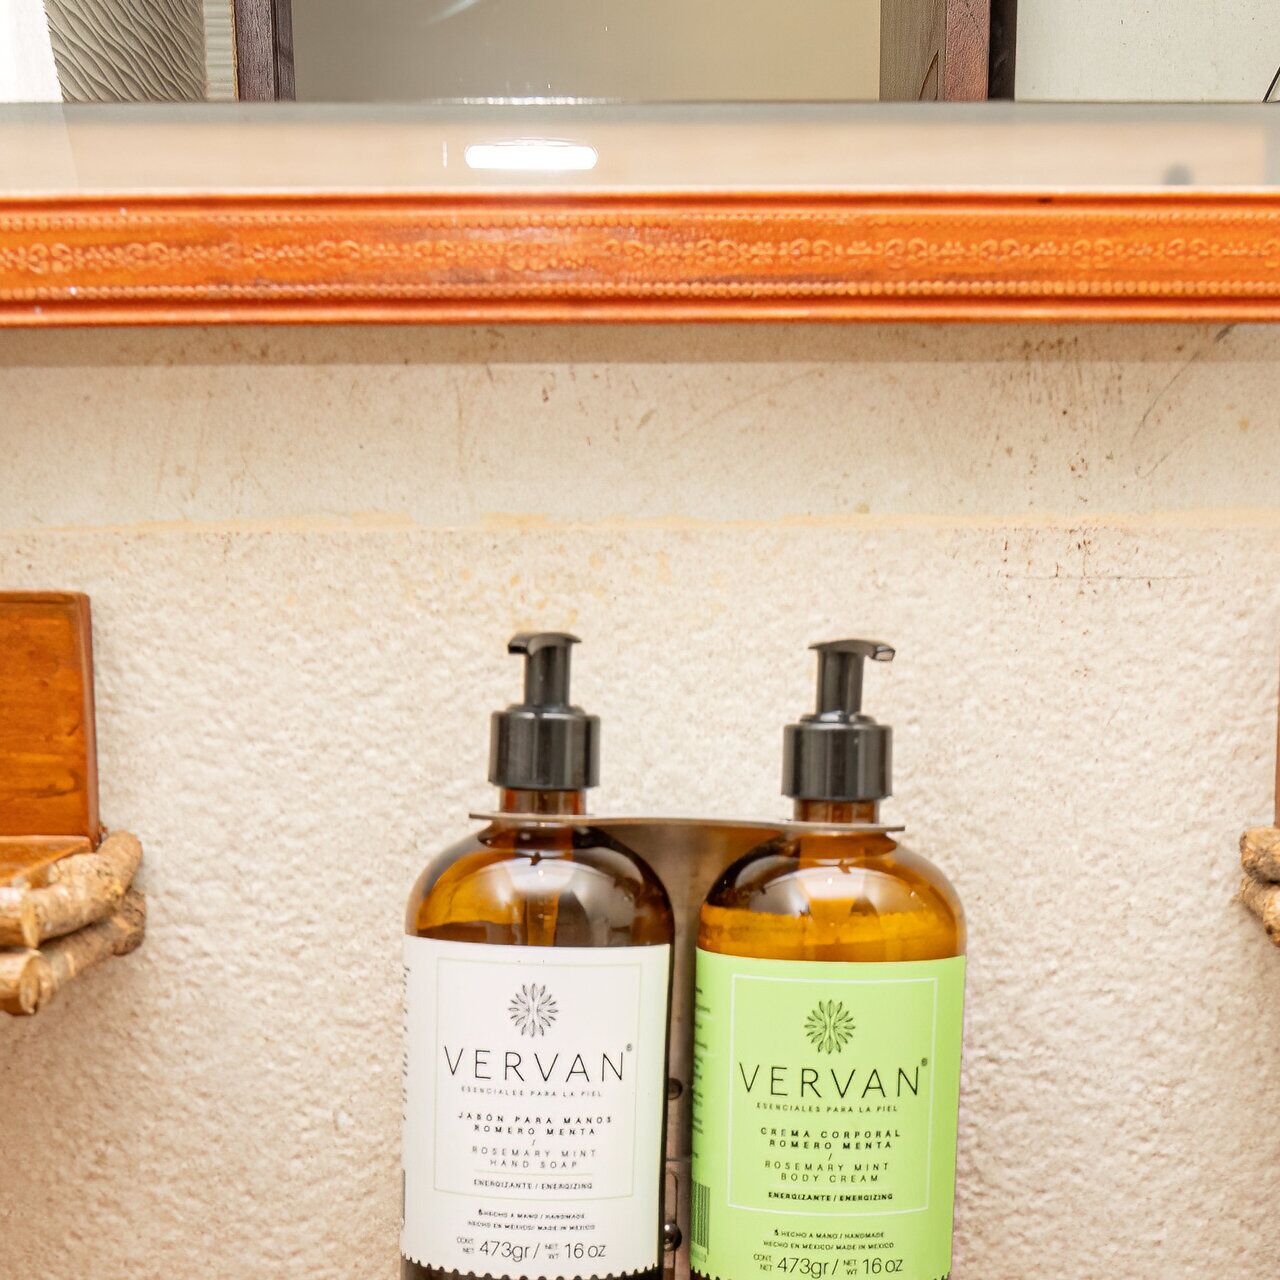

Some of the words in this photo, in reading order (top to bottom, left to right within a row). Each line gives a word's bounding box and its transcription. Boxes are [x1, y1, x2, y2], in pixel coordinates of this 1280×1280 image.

[756, 1102, 820, 1112] ESENCIALES
[515, 1116, 553, 1124] PARA
[563, 1116, 612, 1124] MANOS
[474, 1124, 535, 1135] ROMERO
[546, 1128, 595, 1136] MENTA
[760, 1127, 810, 1138] CREMA
[820, 1129, 901, 1139] CORPORAL
[769, 1139, 832, 1149] ROMERO
[842, 1141, 892, 1149] MENTA
[471, 1146, 551, 1158] ROSEMARY
[561, 1149, 596, 1158] MINT
[490, 1160, 530, 1169] HAND
[540, 1161, 578, 1169] SOAP
[764, 1160, 844, 1171] ROSEMARY
[854, 1162, 890, 1171] MINT
[780, 1172, 820, 1182] BODY
[829, 1173, 880, 1183] CREAM
[473, 1178, 532, 1190] ENERGIZANTE
[541, 1182, 593, 1190] ENERGIZING
[767, 1191, 831, 1201] ENERGIZANTE
[839, 1193, 894, 1201] ENERGIZING
[781, 1231, 806, 1239] HECHO
[844, 1231, 885, 1239] HANDMADE
[763, 1240, 788, 1248] HECHO
